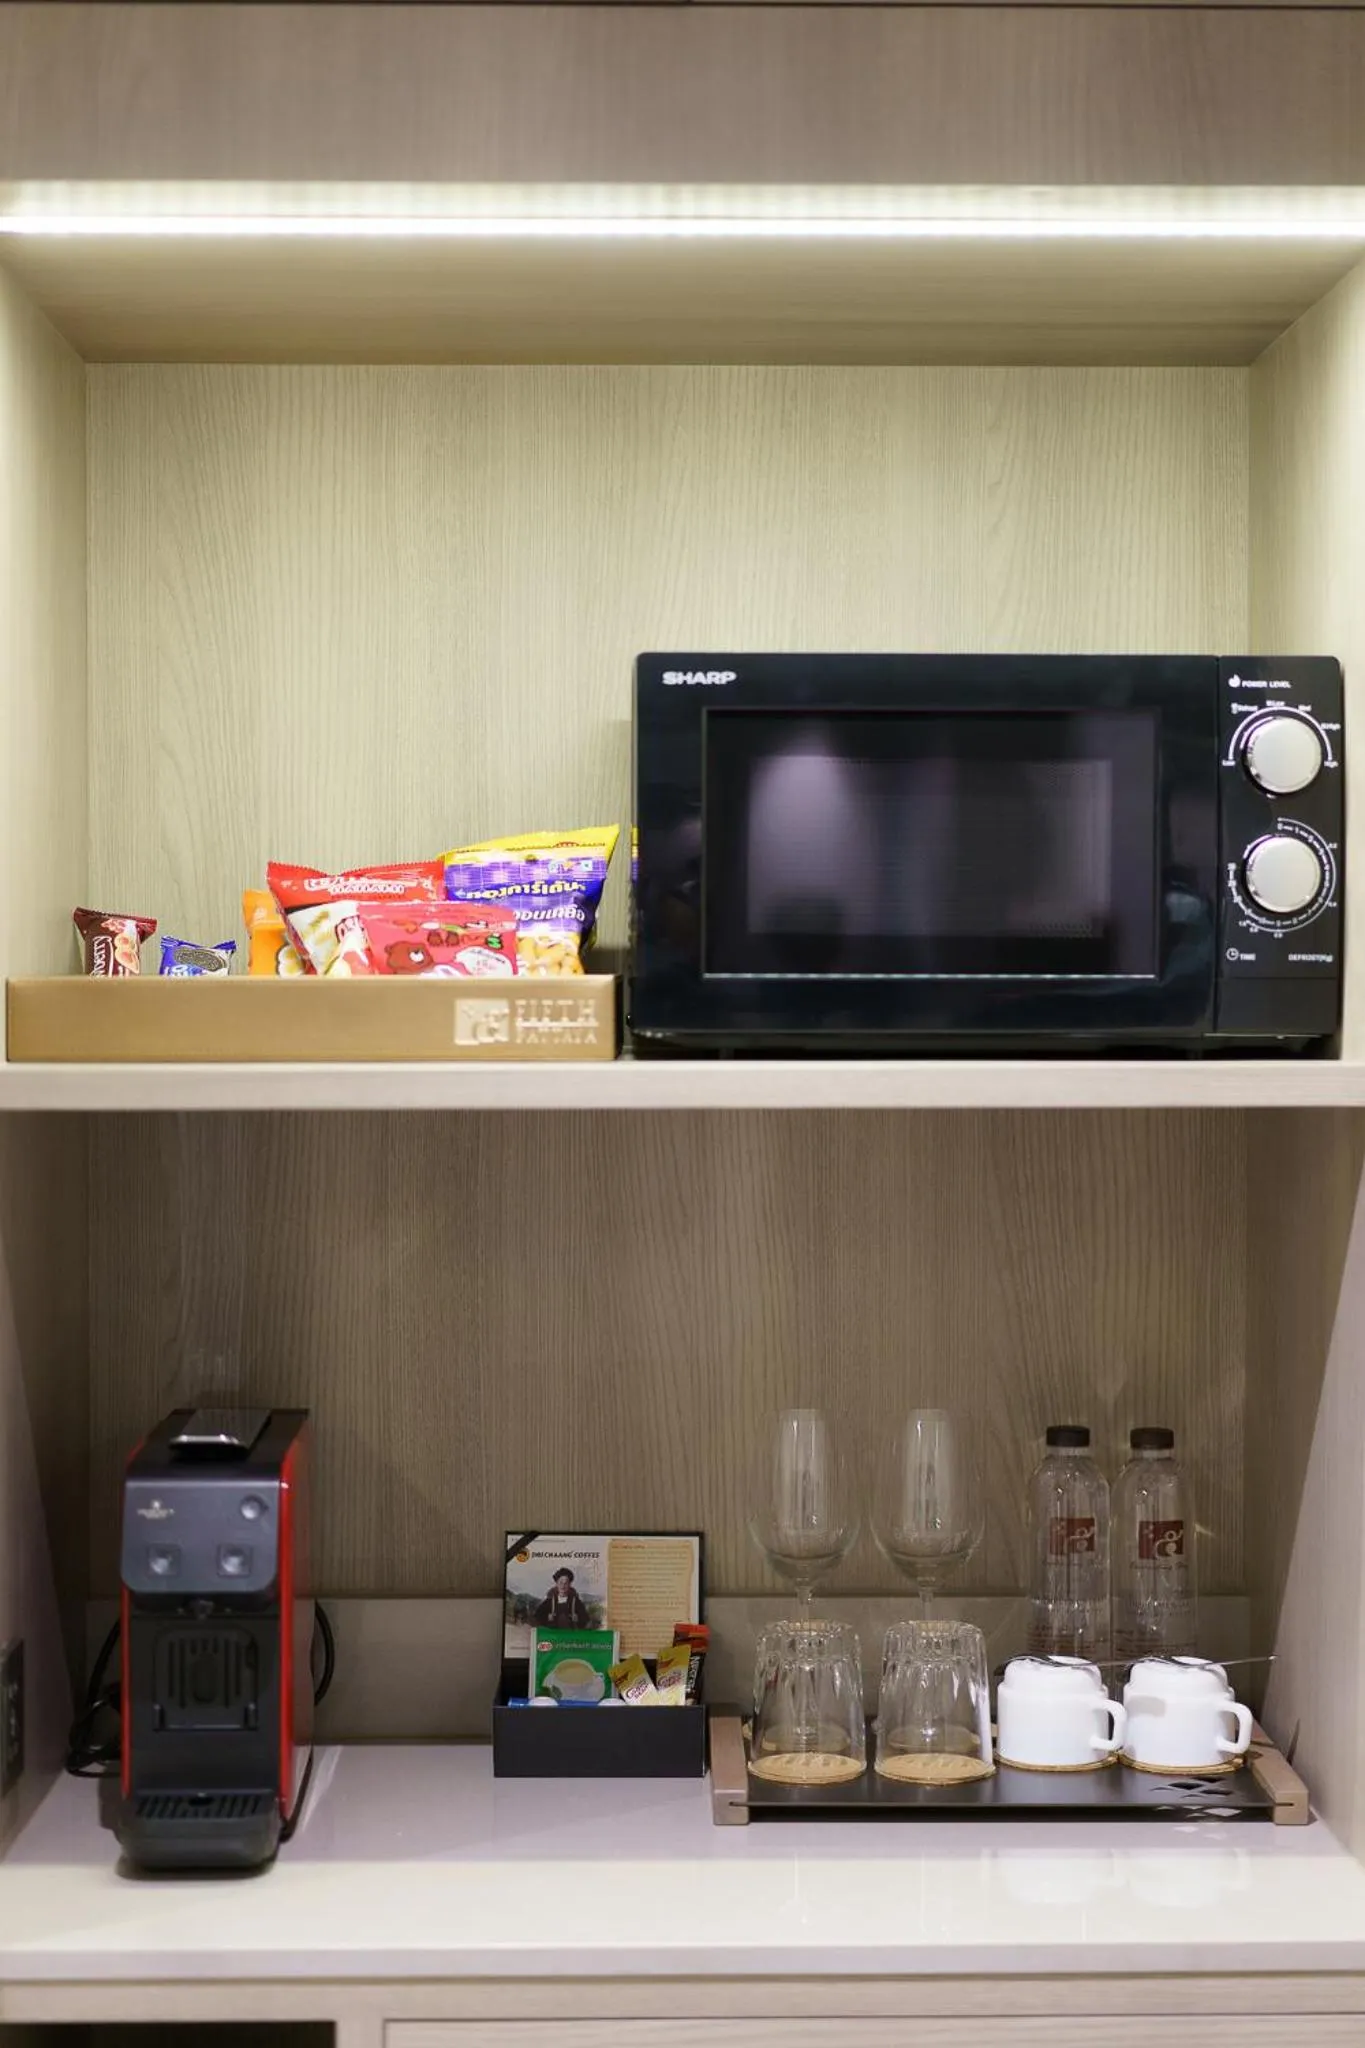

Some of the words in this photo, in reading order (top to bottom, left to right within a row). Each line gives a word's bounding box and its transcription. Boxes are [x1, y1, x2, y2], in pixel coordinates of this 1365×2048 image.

[662, 671, 737, 685] SHARP
[514, 999, 597, 1023] FIFTH
[574, 1551, 600, 1559] COFFEE
